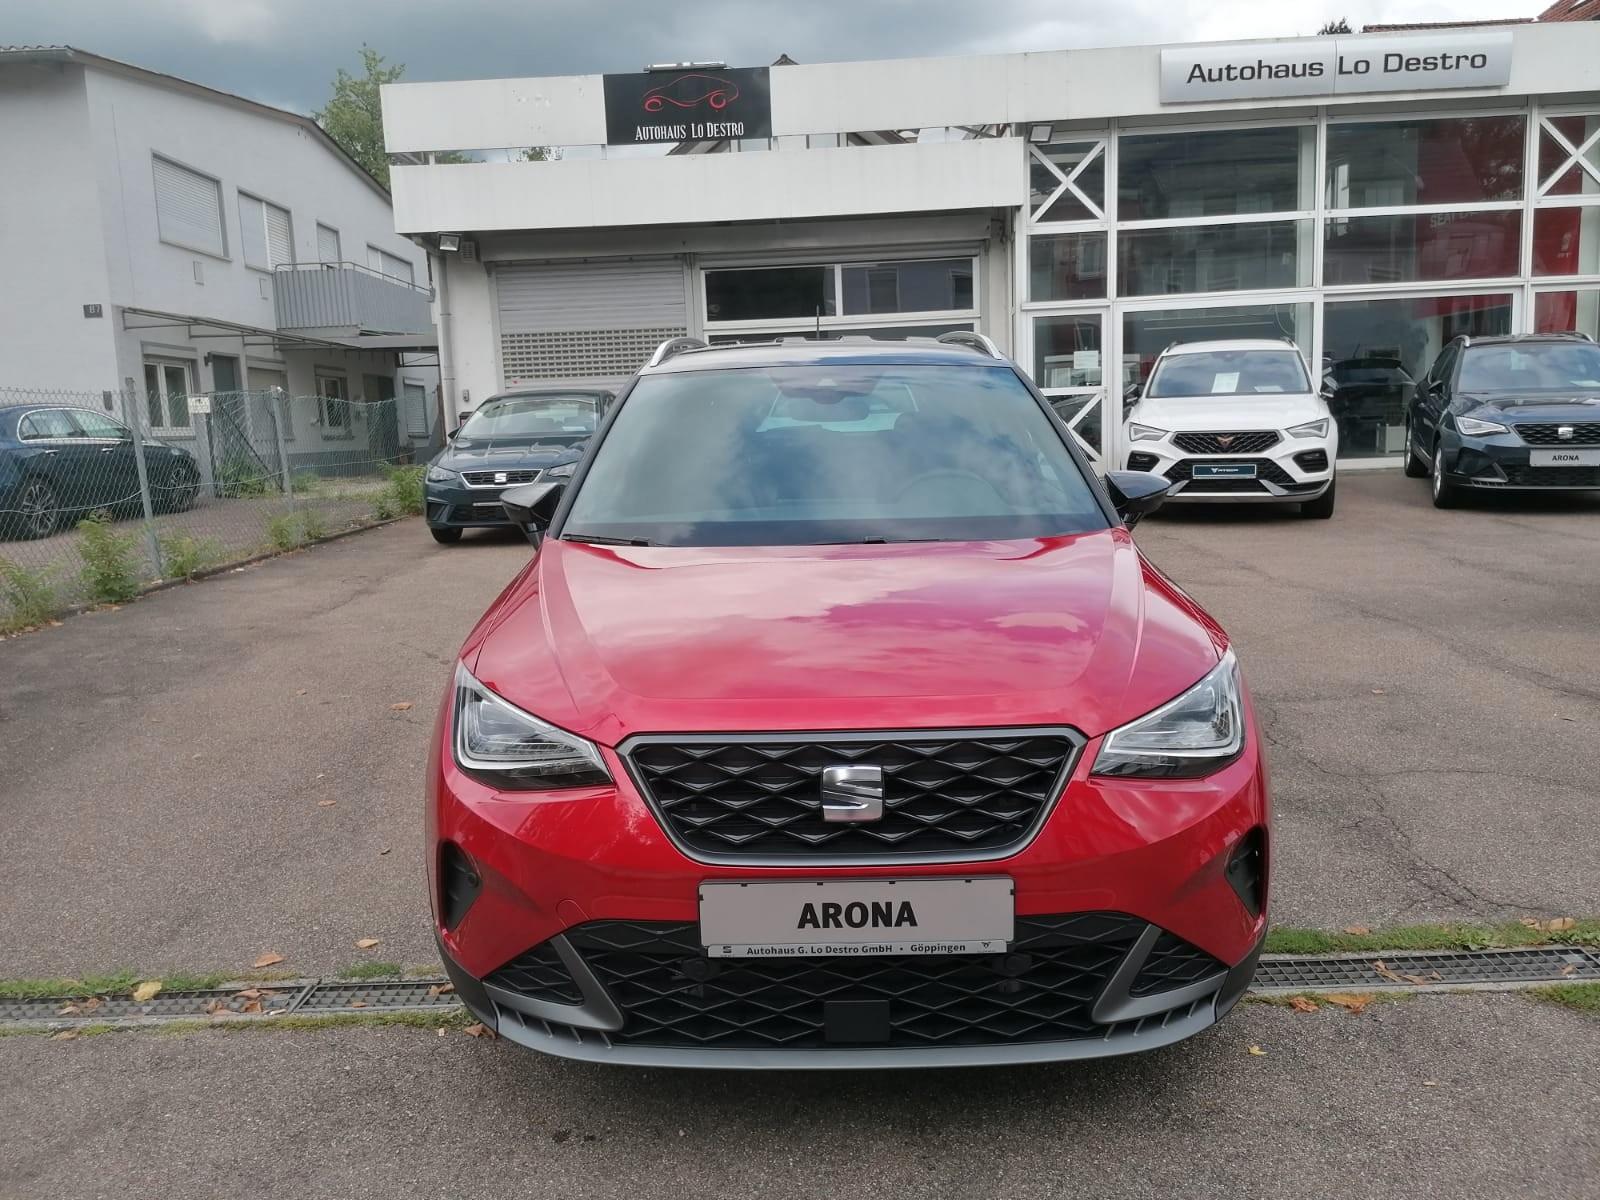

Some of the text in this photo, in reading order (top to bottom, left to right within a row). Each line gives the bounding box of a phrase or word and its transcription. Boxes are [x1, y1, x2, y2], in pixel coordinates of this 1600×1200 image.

[1187, 53, 1487, 84] Autohaus Lo Destro
[635, 121, 745, 141] AUTOHAUS LO DESTRO
[797, 900, 918, 929] ARONA
[746, 942, 967, 955] Autohaus G. Lo Destro GmbH Göppingen
